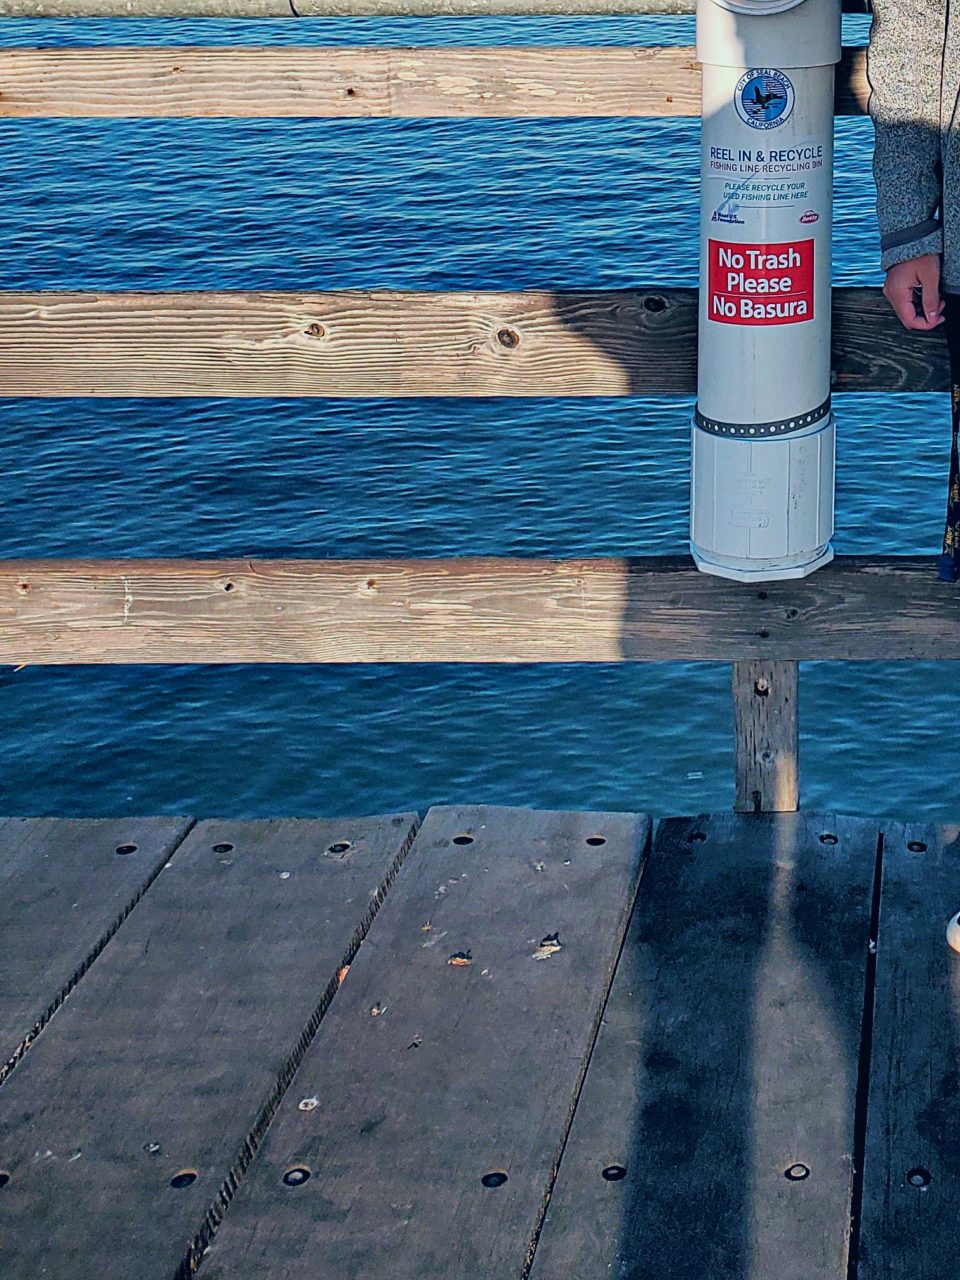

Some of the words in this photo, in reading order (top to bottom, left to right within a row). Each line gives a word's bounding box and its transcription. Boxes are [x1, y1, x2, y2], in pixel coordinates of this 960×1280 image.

[737, 79, 747, 92] CITY
[746, 72, 755, 80] OF
[773, 72, 791, 90] BEACH
[746, 117, 785, 129] CALIFORNIA
[710, 147, 735, 161] REEL
[738, 150, 752, 162] IN
[756, 150, 765, 162] &
[769, 145, 823, 162] RECYCLE
[710, 161, 738, 172] FISHING
[740, 164, 760, 173] LINE
[762, 161, 811, 173] RECYCLING
[812, 159, 823, 169] BIN
[723, 192, 740, 200] USED
[741, 193, 771, 201] FISHING
[772, 192, 790, 200] LINE
[790, 190, 809, 200] HERE
[724, 182, 750, 191] PLEASE
[751, 183, 785, 192] RECYCLE
[787, 182, 806, 190] YOUR
[719, 247, 744, 269] No
[745, 247, 801, 270] Trash
[727, 272, 792, 293] Please
[713, 295, 737, 317] No
[740, 298, 808, 319] Basura
